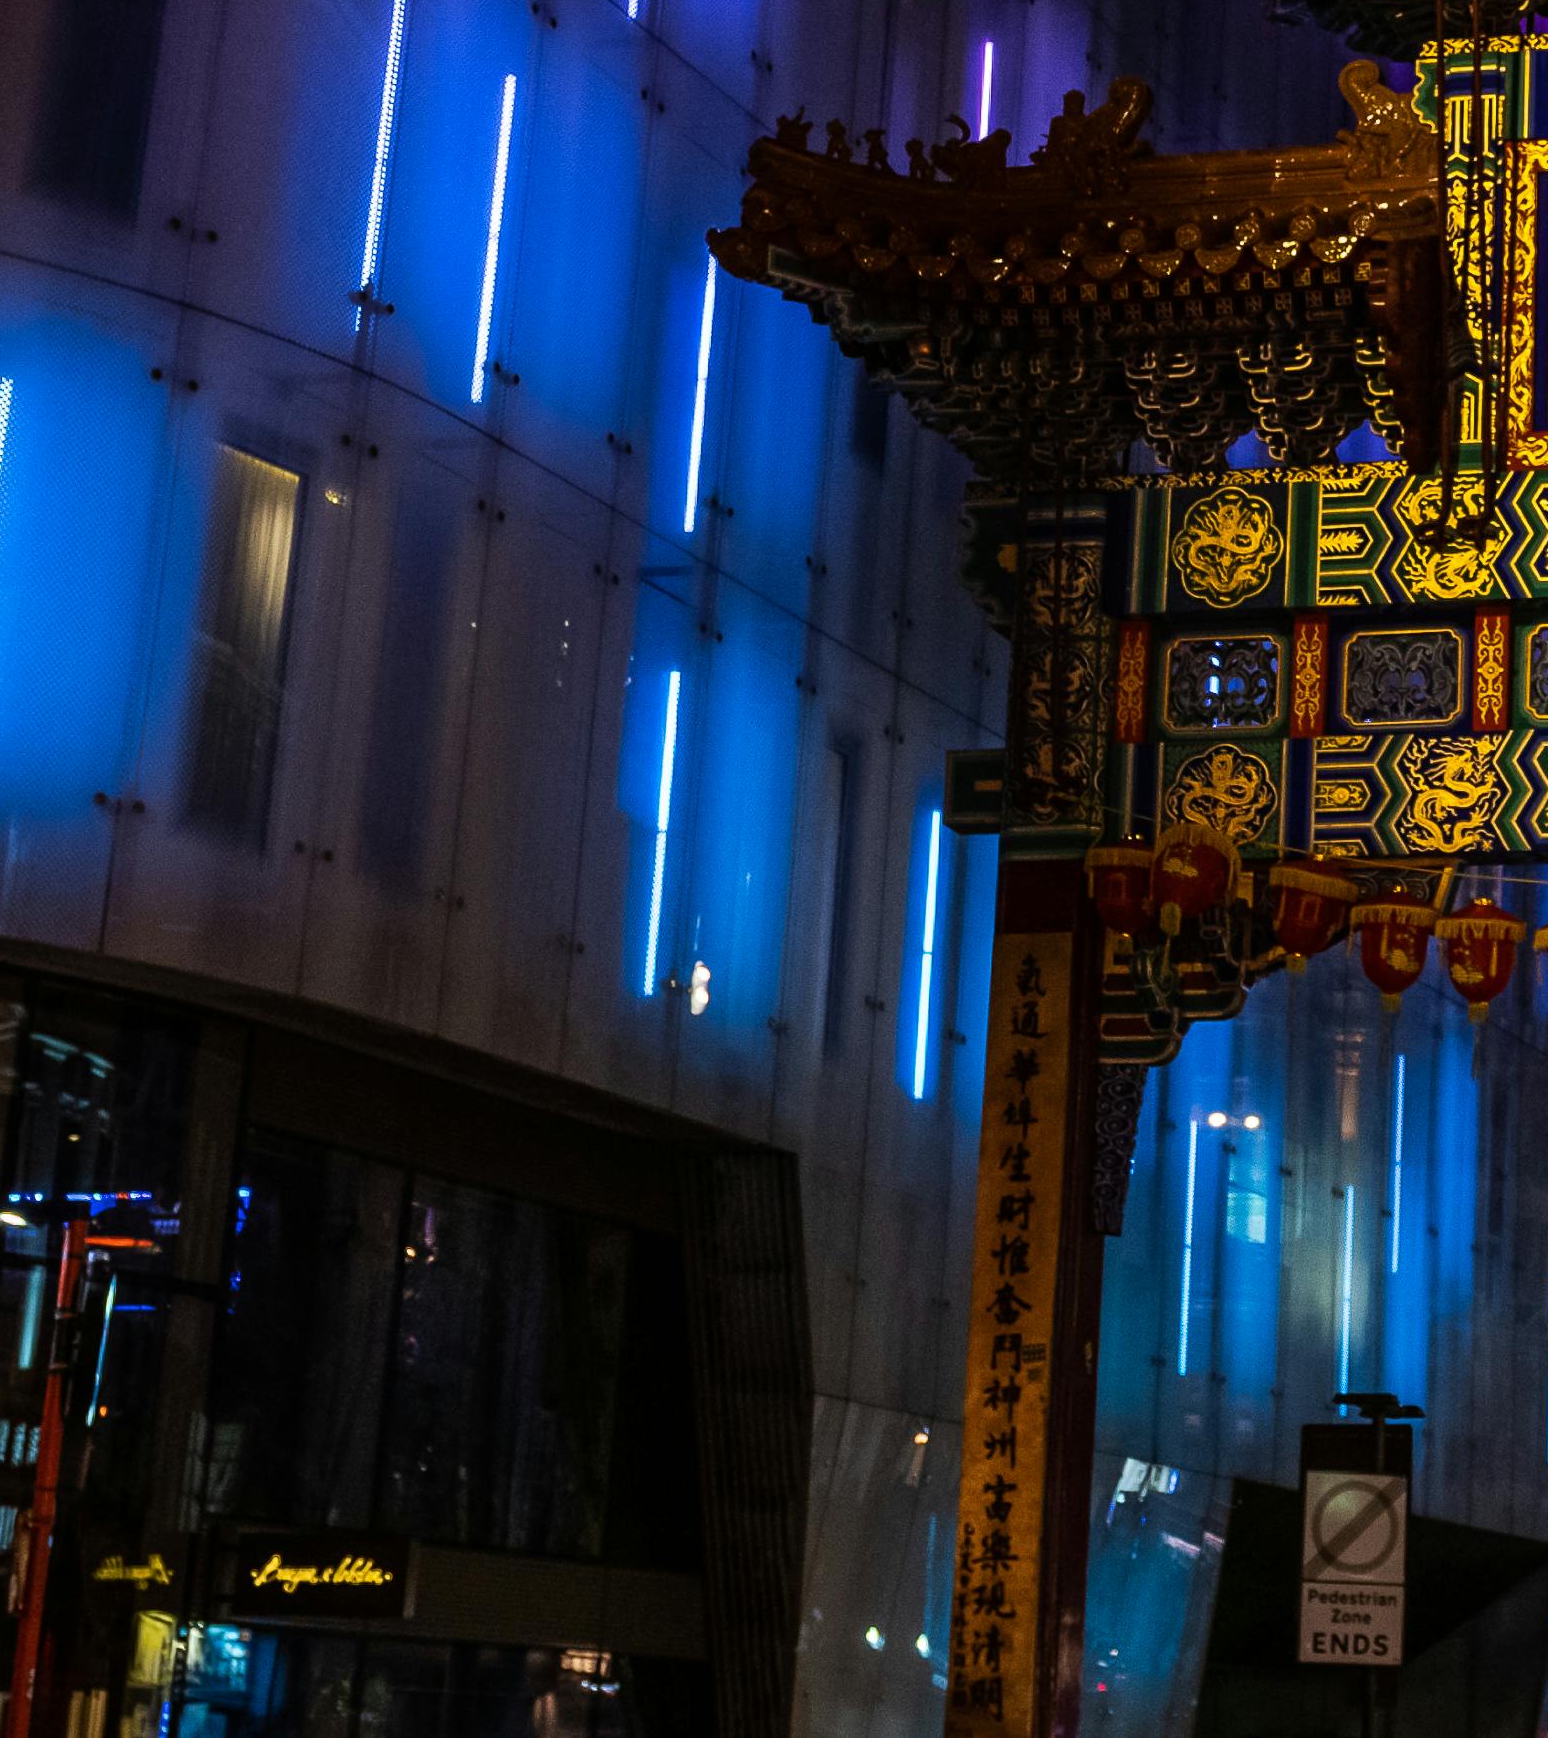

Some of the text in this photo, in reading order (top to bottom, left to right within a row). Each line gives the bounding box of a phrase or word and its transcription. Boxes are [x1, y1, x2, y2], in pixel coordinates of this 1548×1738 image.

[1307, 1589, 1397, 1607] Pedestrian
[1330, 1608, 1372, 1625] Zone
[1311, 1631, 1390, 1657] ENDS
